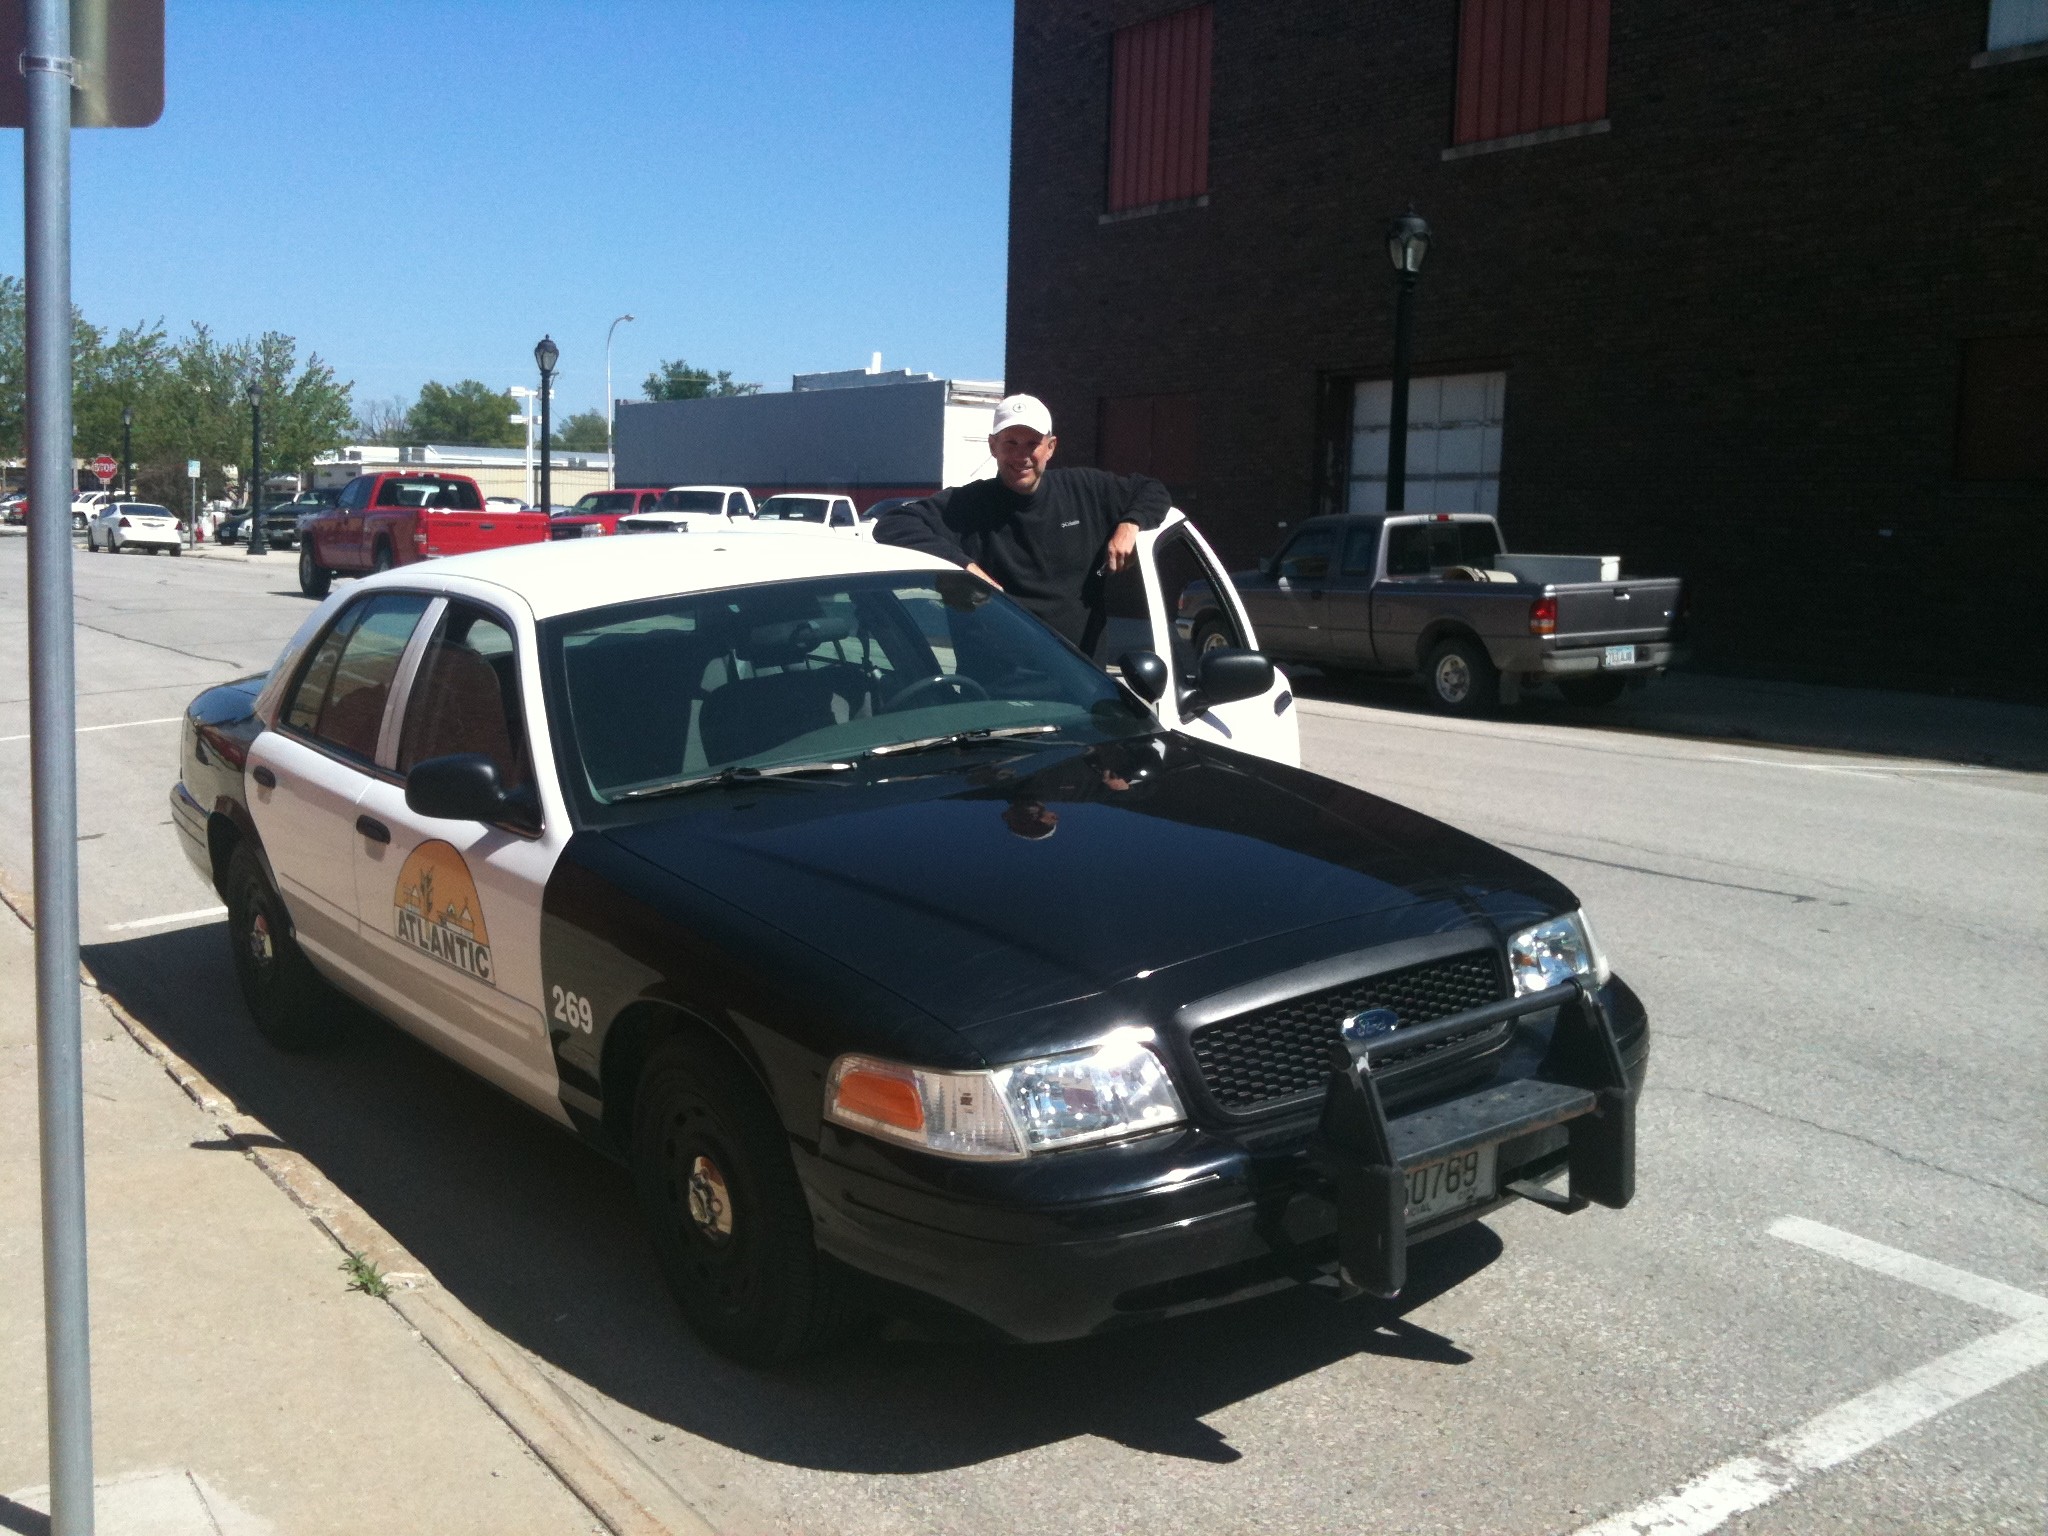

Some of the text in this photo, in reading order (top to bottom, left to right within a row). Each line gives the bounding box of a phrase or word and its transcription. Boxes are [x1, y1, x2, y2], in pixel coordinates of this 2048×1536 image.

[93, 463, 116, 472] STOP
[399, 910, 490, 978] ATLANTIC
[553, 985, 593, 1034] 269
